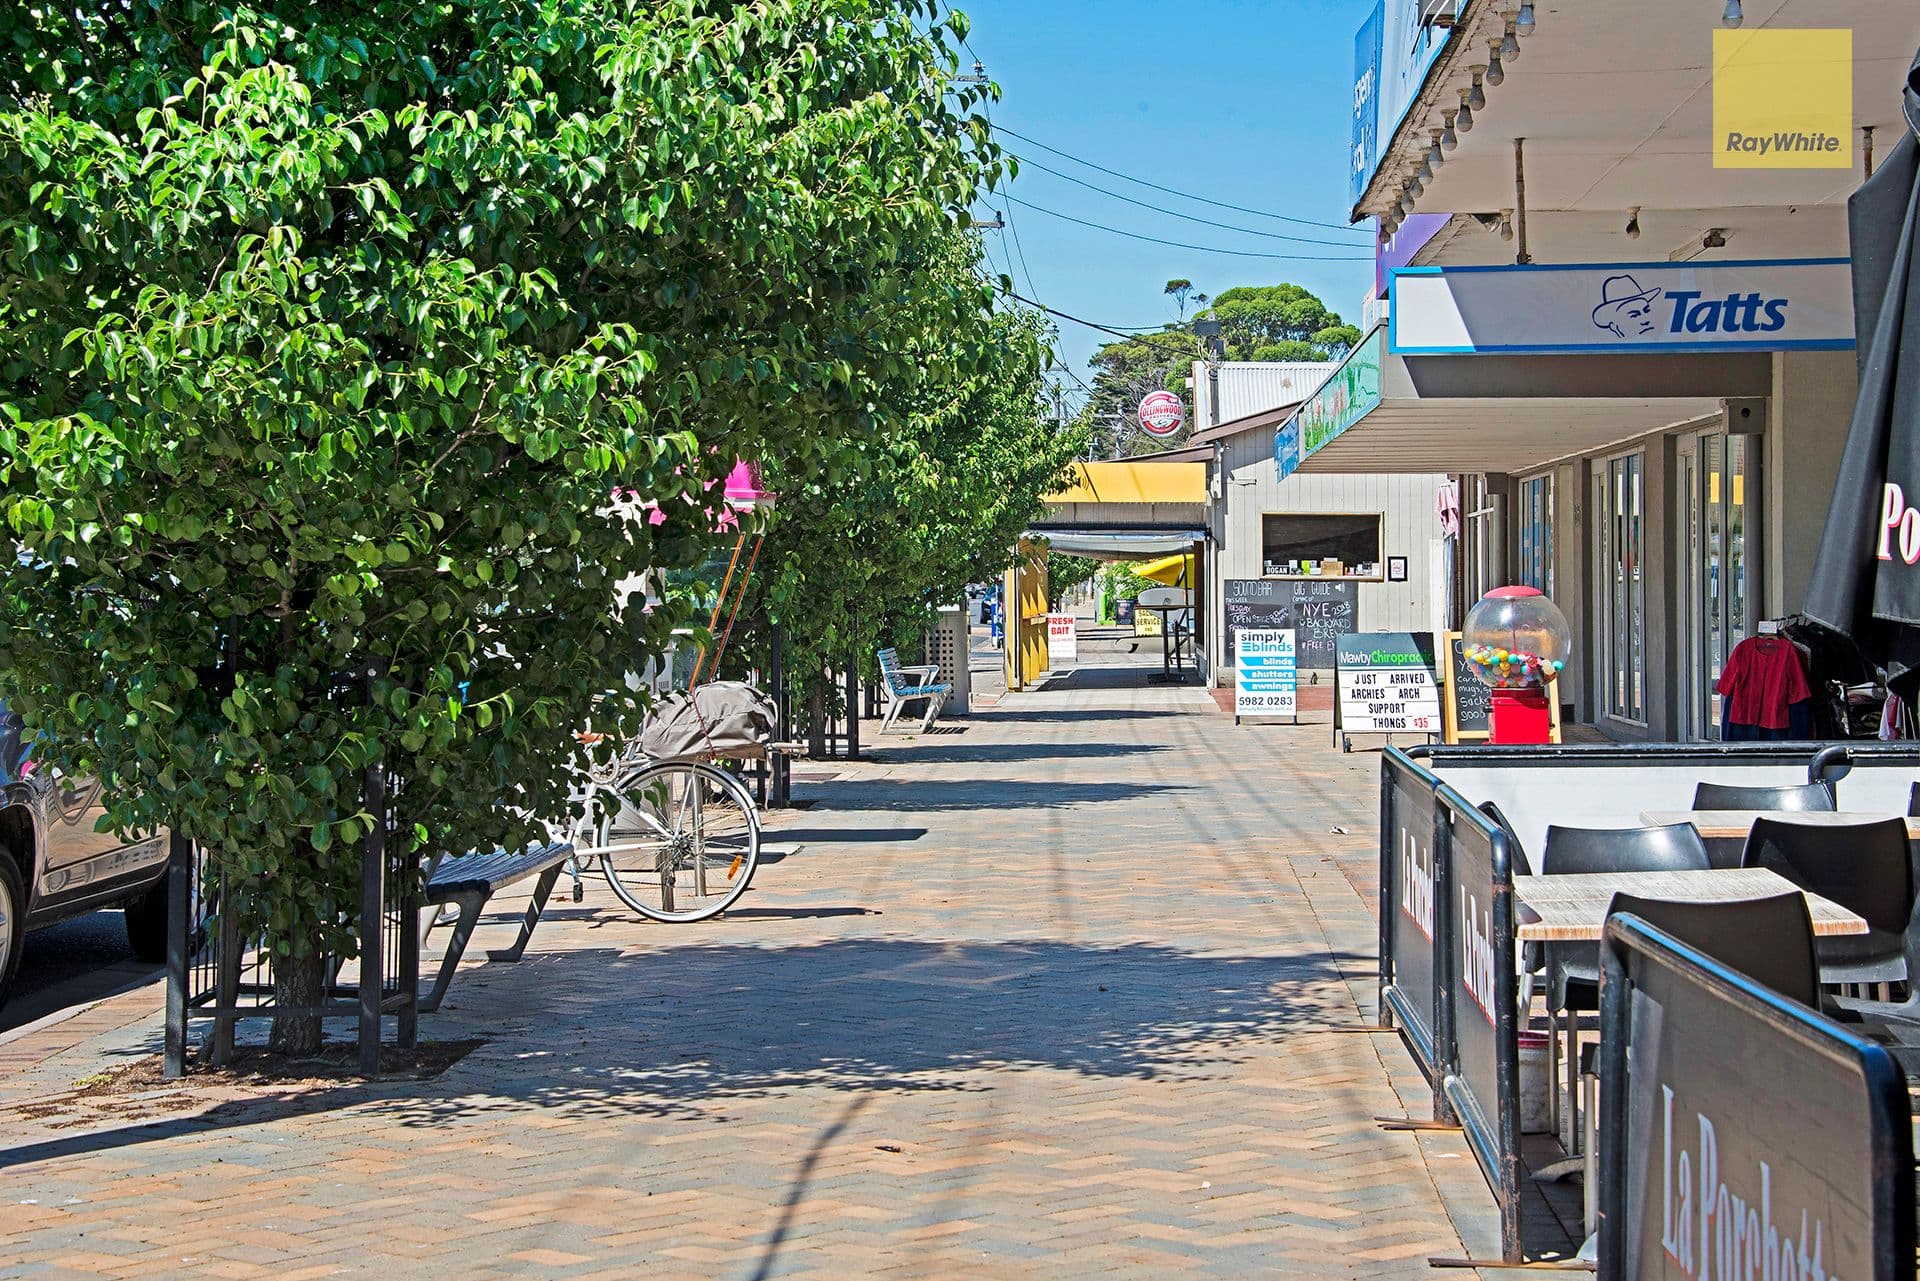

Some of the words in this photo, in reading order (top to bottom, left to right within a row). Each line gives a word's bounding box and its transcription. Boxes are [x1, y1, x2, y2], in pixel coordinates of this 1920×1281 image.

[1664, 291, 1788, 333] Tatts
[1140, 405, 1182, 420] COLLINGWOOD
[1311, 582, 1331, 596] GUIDE
[1302, 602, 1331, 617] NYE
[1047, 617, 1074, 625] FRESH
[1232, 615, 1251, 624] OPEN
[1306, 617, 1352, 629] BACKYARD
[1051, 626, 1070, 635] BAIT
[1241, 632, 1285, 643] simply
[1252, 642, 1293, 652] blinds
[1263, 657, 1293, 666] blinds
[1251, 670, 1293, 678] shutters
[1354, 673, 1377, 685] JUST
[1390, 673, 1425, 684] ARRIVED
[1251, 683, 1293, 692] awnings
[1351, 688, 1385, 699] ARCHIES
[1398, 688, 1420, 699] ARCH
[1239, 696, 1264, 706] 5982
[1267, 696, 1293, 706] 0283
[1368, 703, 1406, 714] SUPPORT
[1373, 718, 1406, 729] THONGS
[1413, 717, 1429, 728] $35
[1662, 1083, 1694, 1280] La
